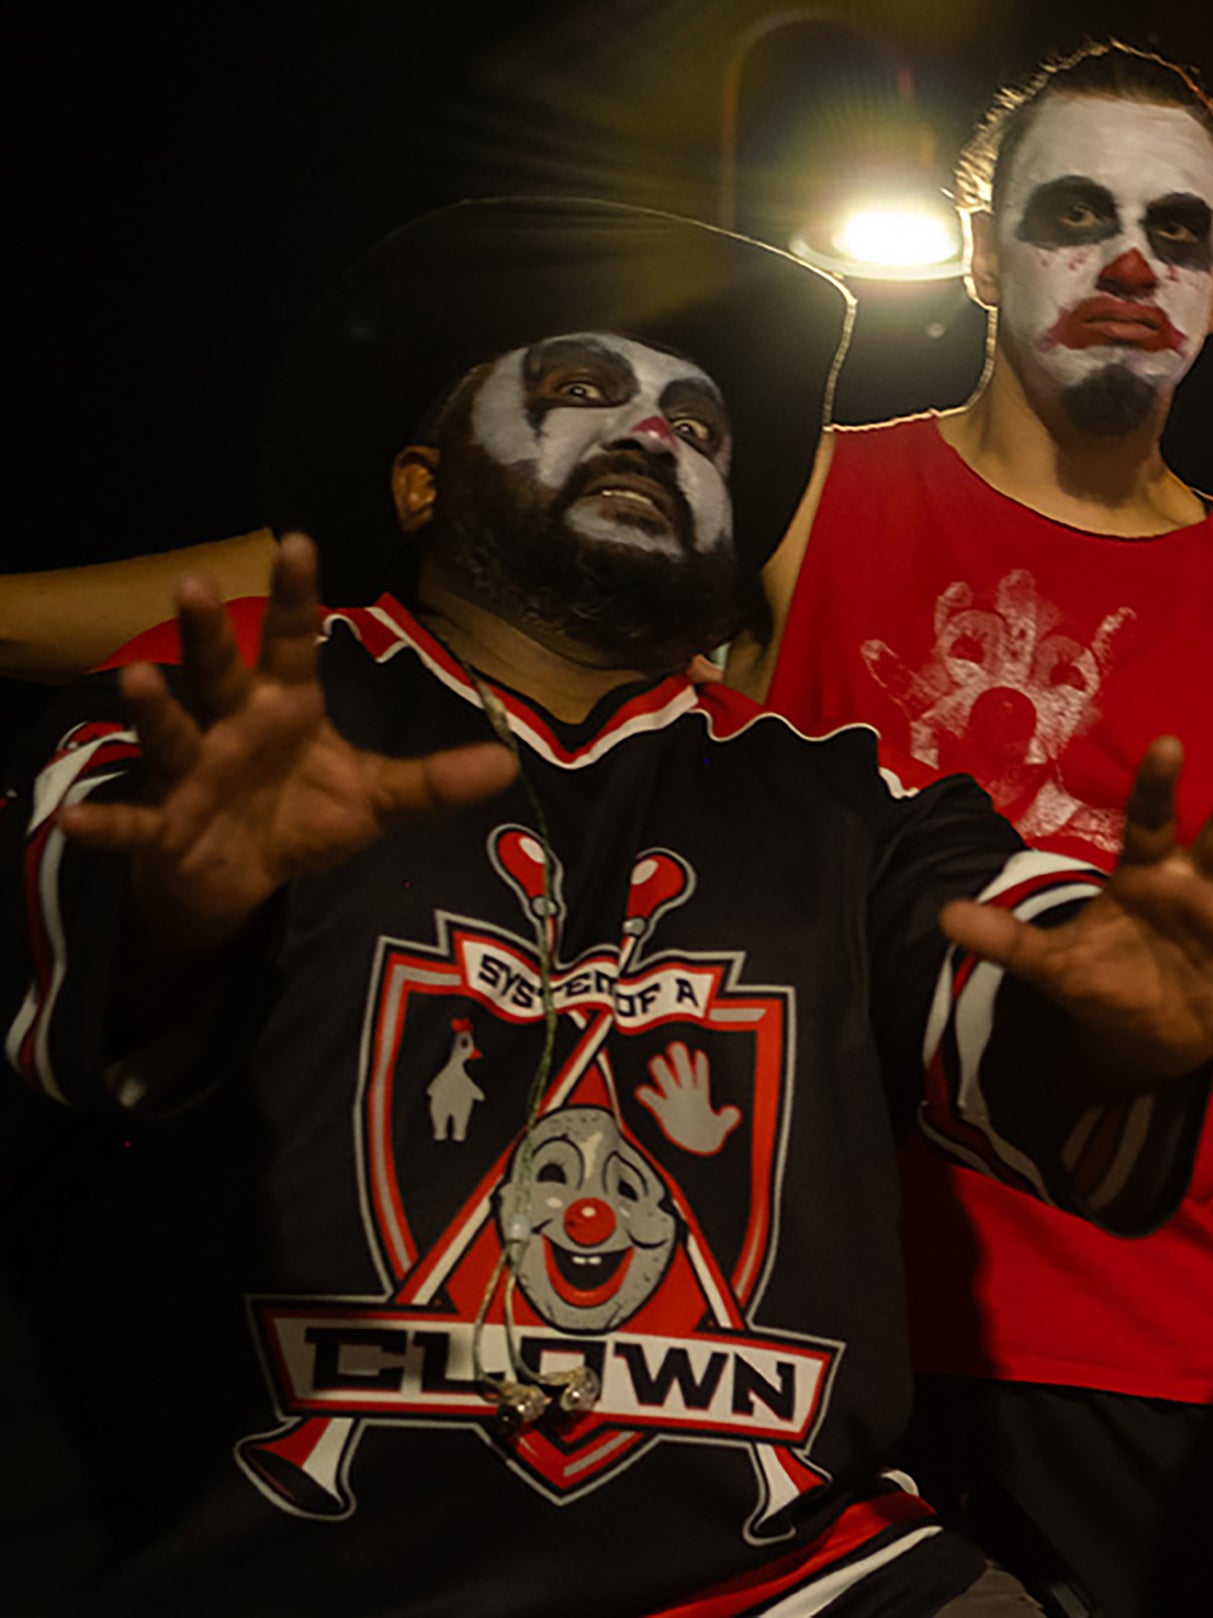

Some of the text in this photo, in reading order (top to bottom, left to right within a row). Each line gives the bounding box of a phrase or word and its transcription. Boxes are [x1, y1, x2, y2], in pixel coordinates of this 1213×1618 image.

[615, 982, 661, 1018] OF
[674, 977, 699, 1008] A
[304, 1326, 797, 1423] CLOWN
